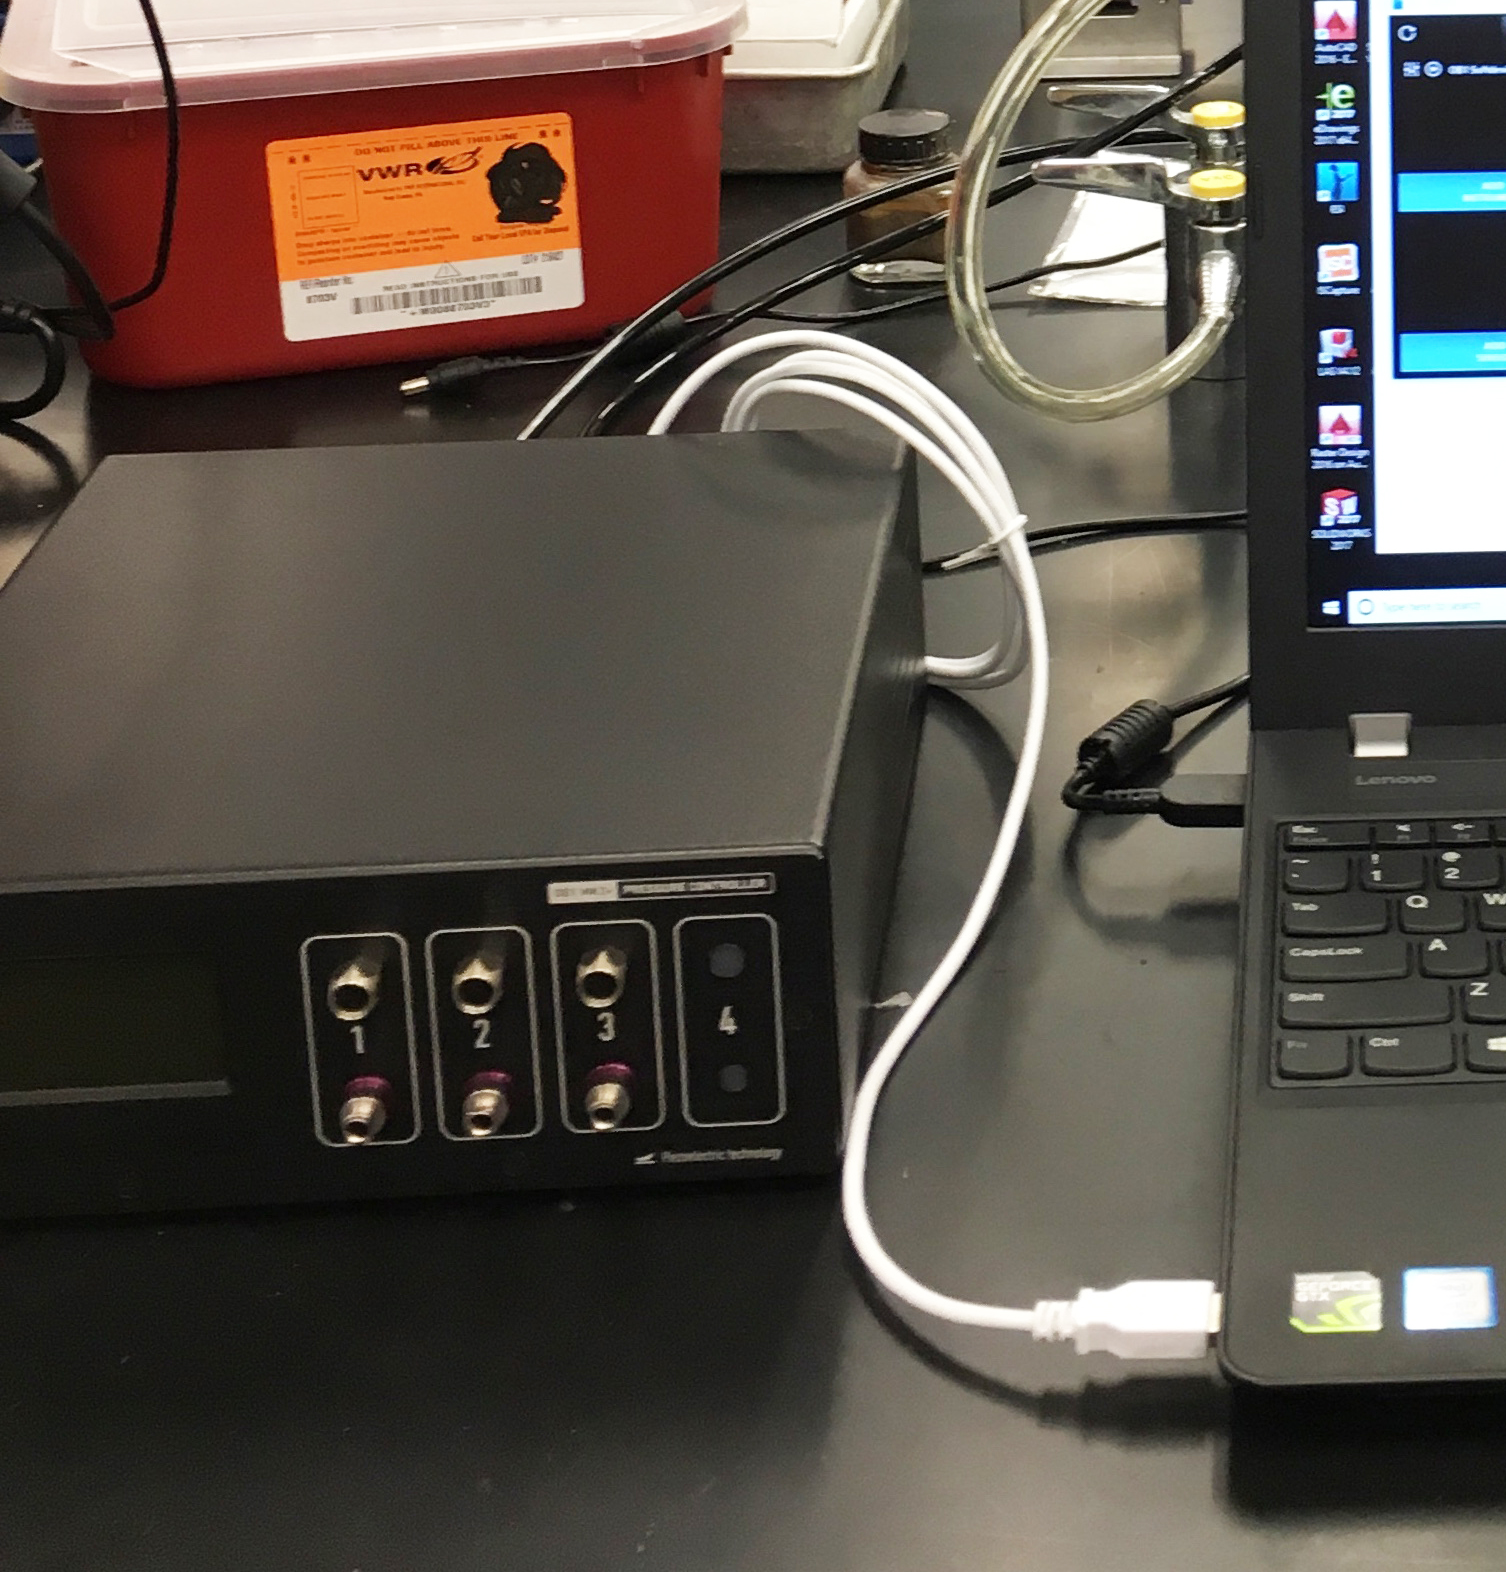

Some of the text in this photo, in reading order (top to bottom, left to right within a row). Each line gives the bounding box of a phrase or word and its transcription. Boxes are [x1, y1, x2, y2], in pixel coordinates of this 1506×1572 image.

[356, 163, 423, 181] VWR
[1354, 775, 1437, 786] Lenovo
[1370, 869, 1382, 881] 1
[1444, 867, 1460, 879] 2
[1405, 895, 1429, 909] Q
[1427, 938, 1448, 952] A
[1469, 982, 1489, 996] Z
[718, 1005, 739, 1035] 4
[473, 1019, 491, 1049] 2
[597, 1012, 616, 1043] 3
[349, 1026, 367, 1054] 1
[1295, 1281, 1373, 1292] GEFORCE
